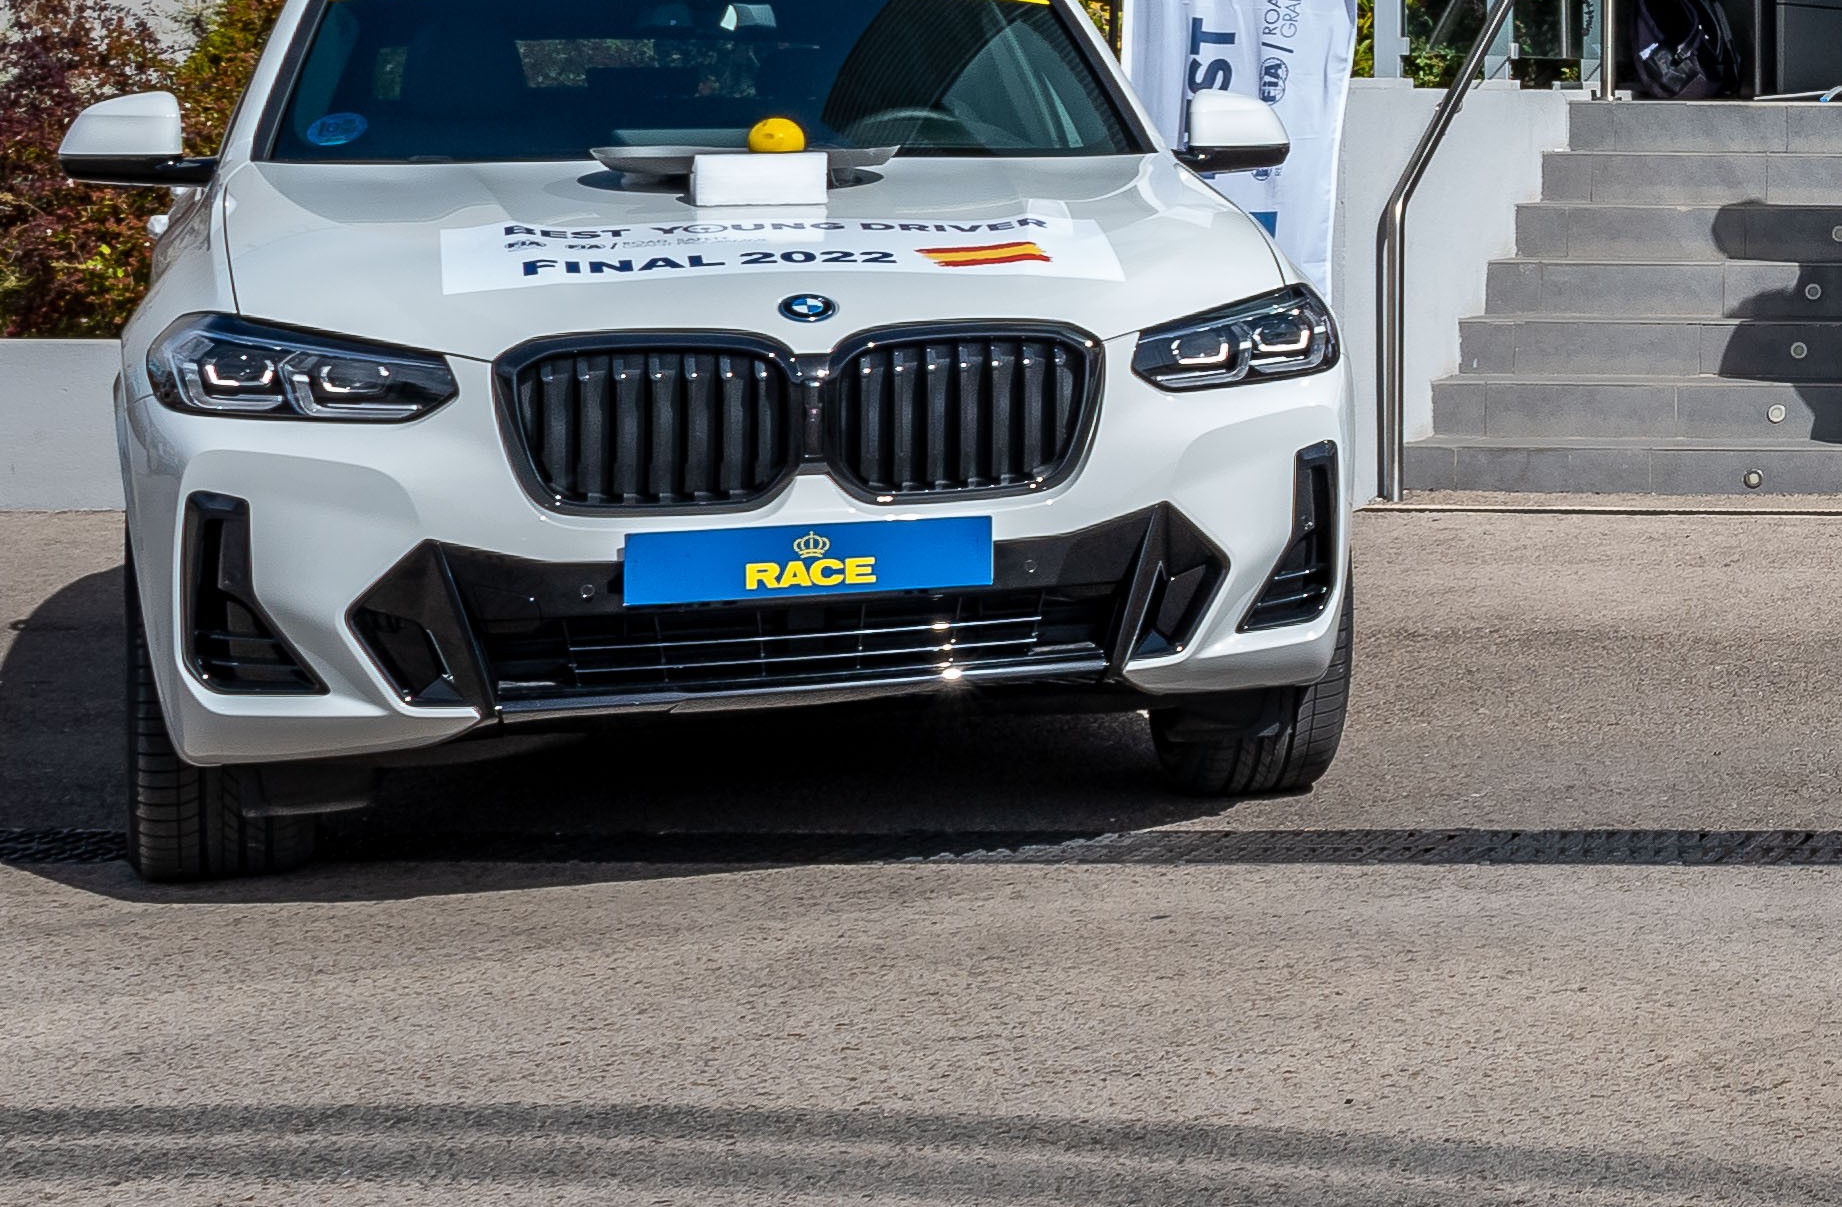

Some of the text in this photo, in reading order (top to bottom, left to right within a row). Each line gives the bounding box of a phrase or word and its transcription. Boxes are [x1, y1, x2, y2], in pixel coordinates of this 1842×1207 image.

[503, 216, 1050, 239] BEST YOUNG DRIVER
[522, 248, 899, 277] FINAL 2022
[745, 556, 877, 590] RACE
